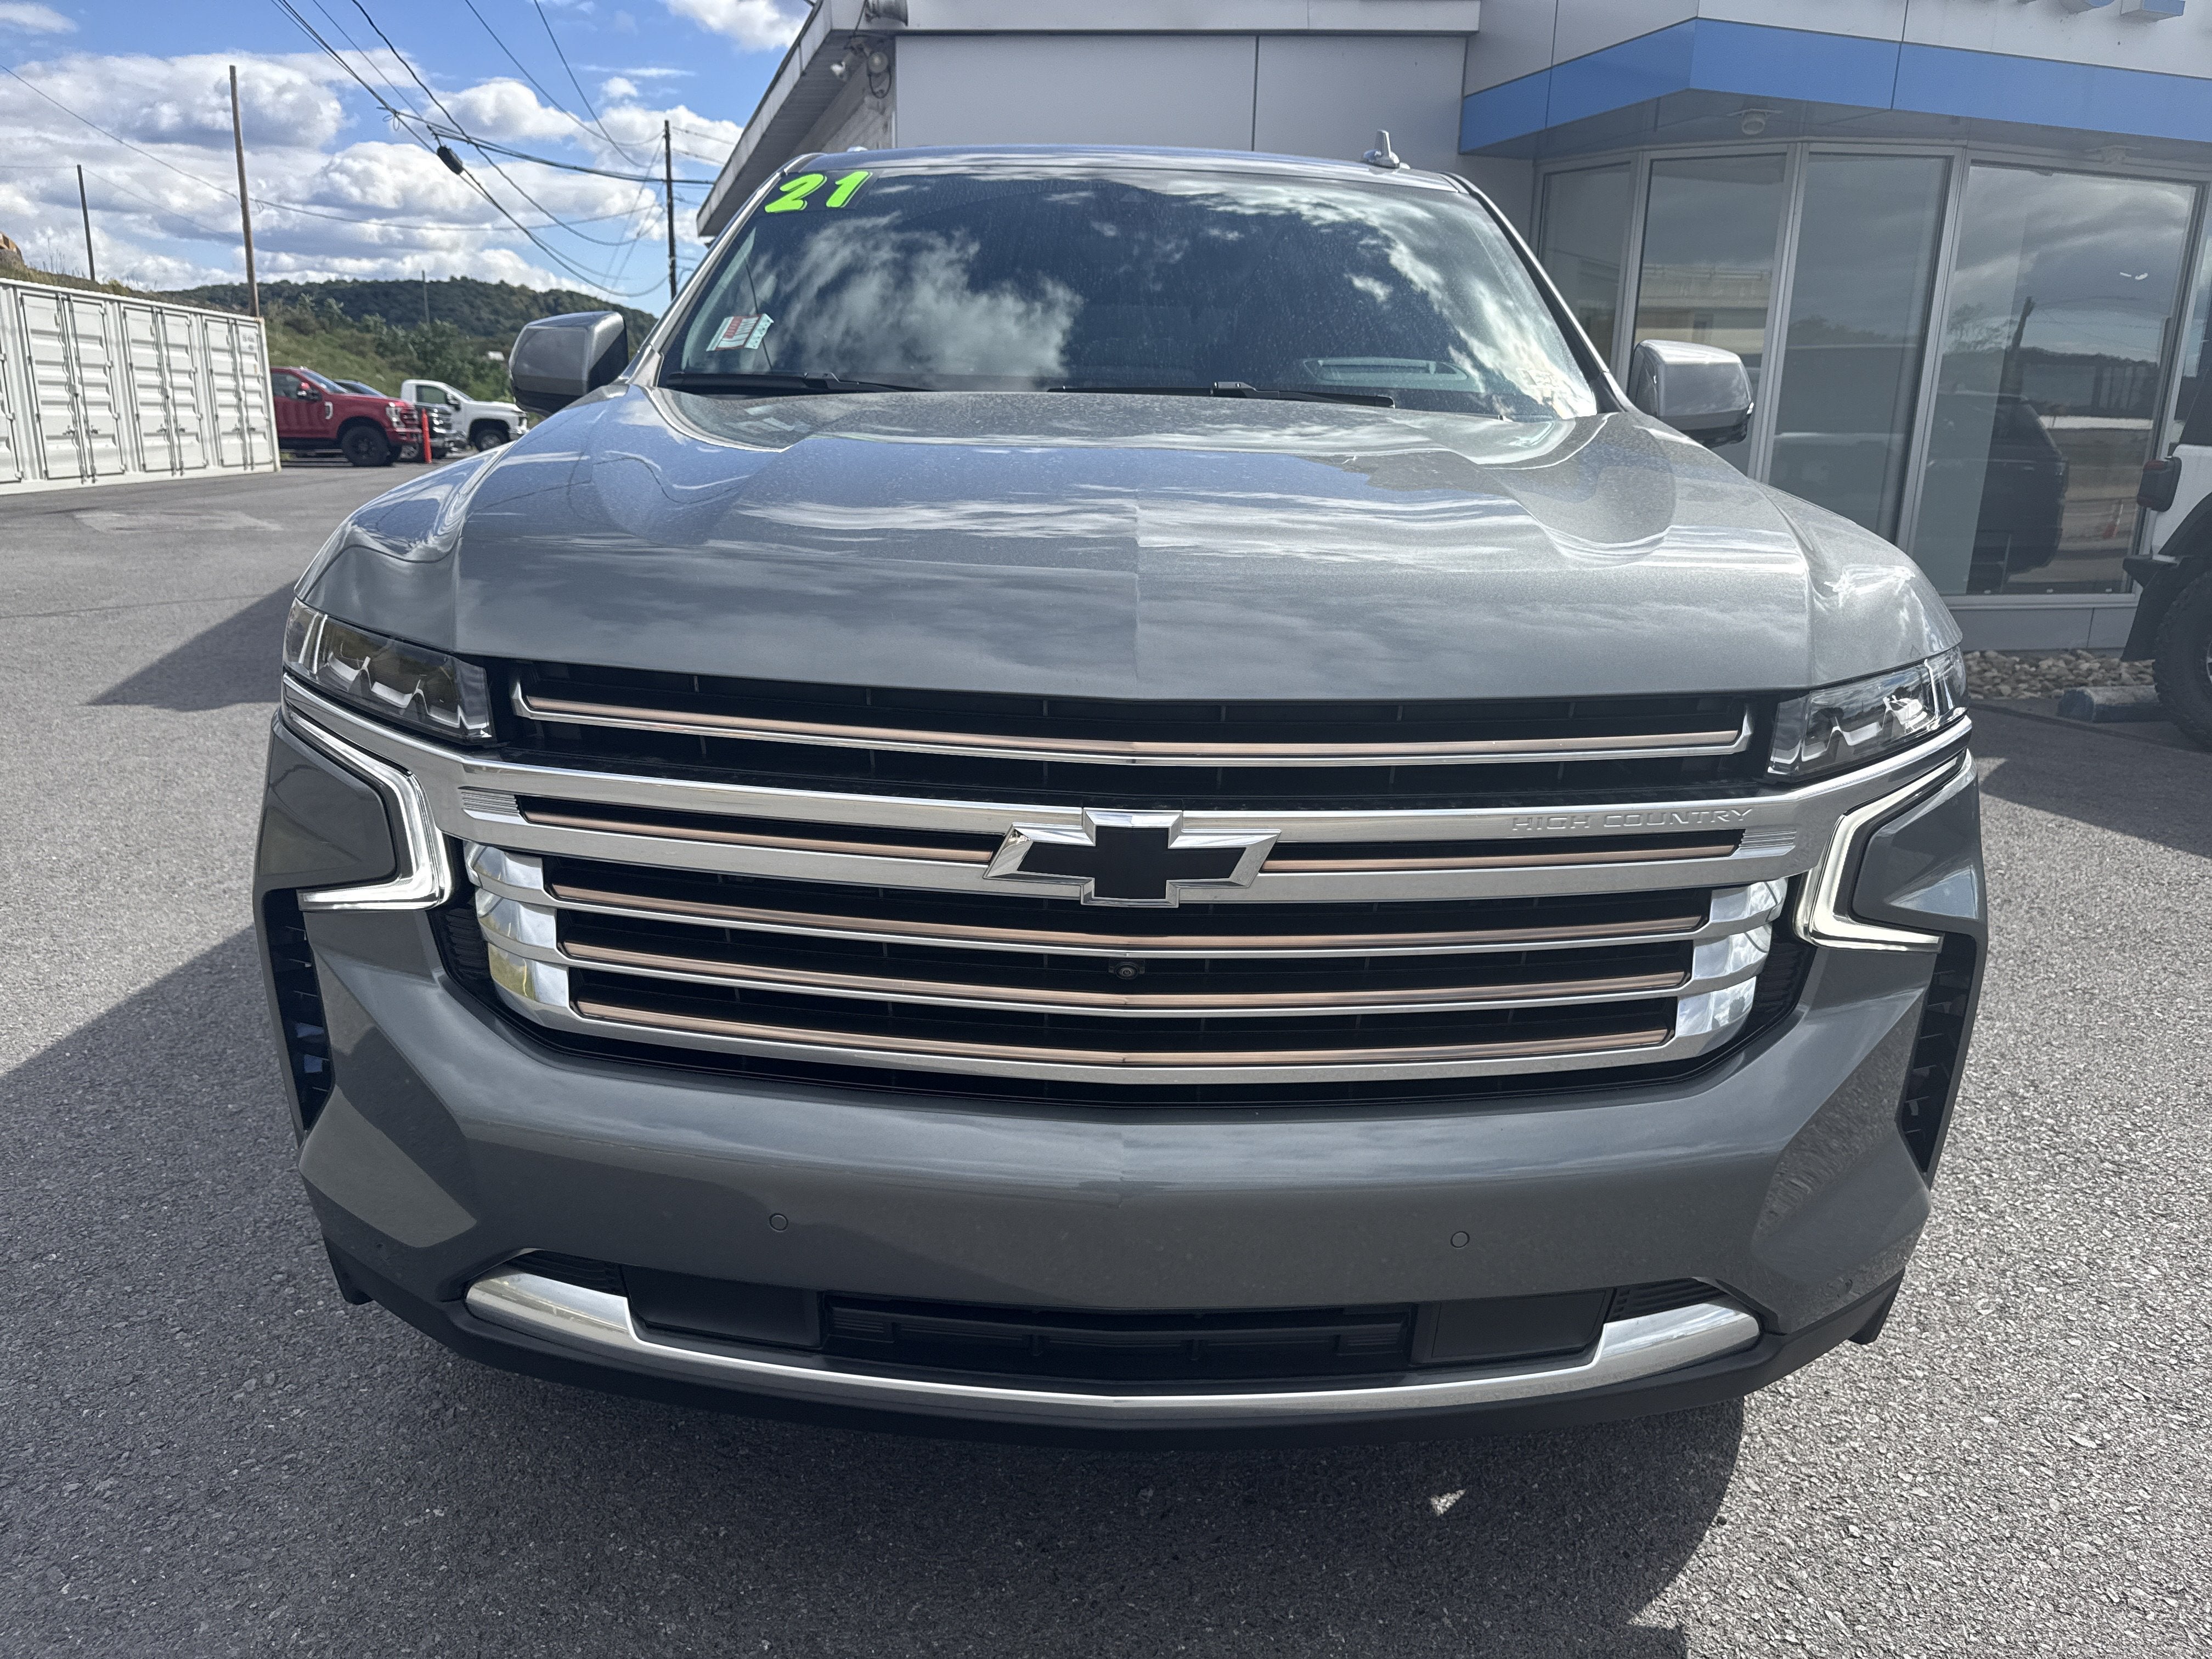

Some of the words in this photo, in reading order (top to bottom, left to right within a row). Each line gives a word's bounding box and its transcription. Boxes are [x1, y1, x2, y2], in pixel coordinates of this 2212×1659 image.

[765, 171, 873, 213] 21
[1512, 815, 1590, 831] HIGH
[1603, 808, 1753, 827] COUNTRY
